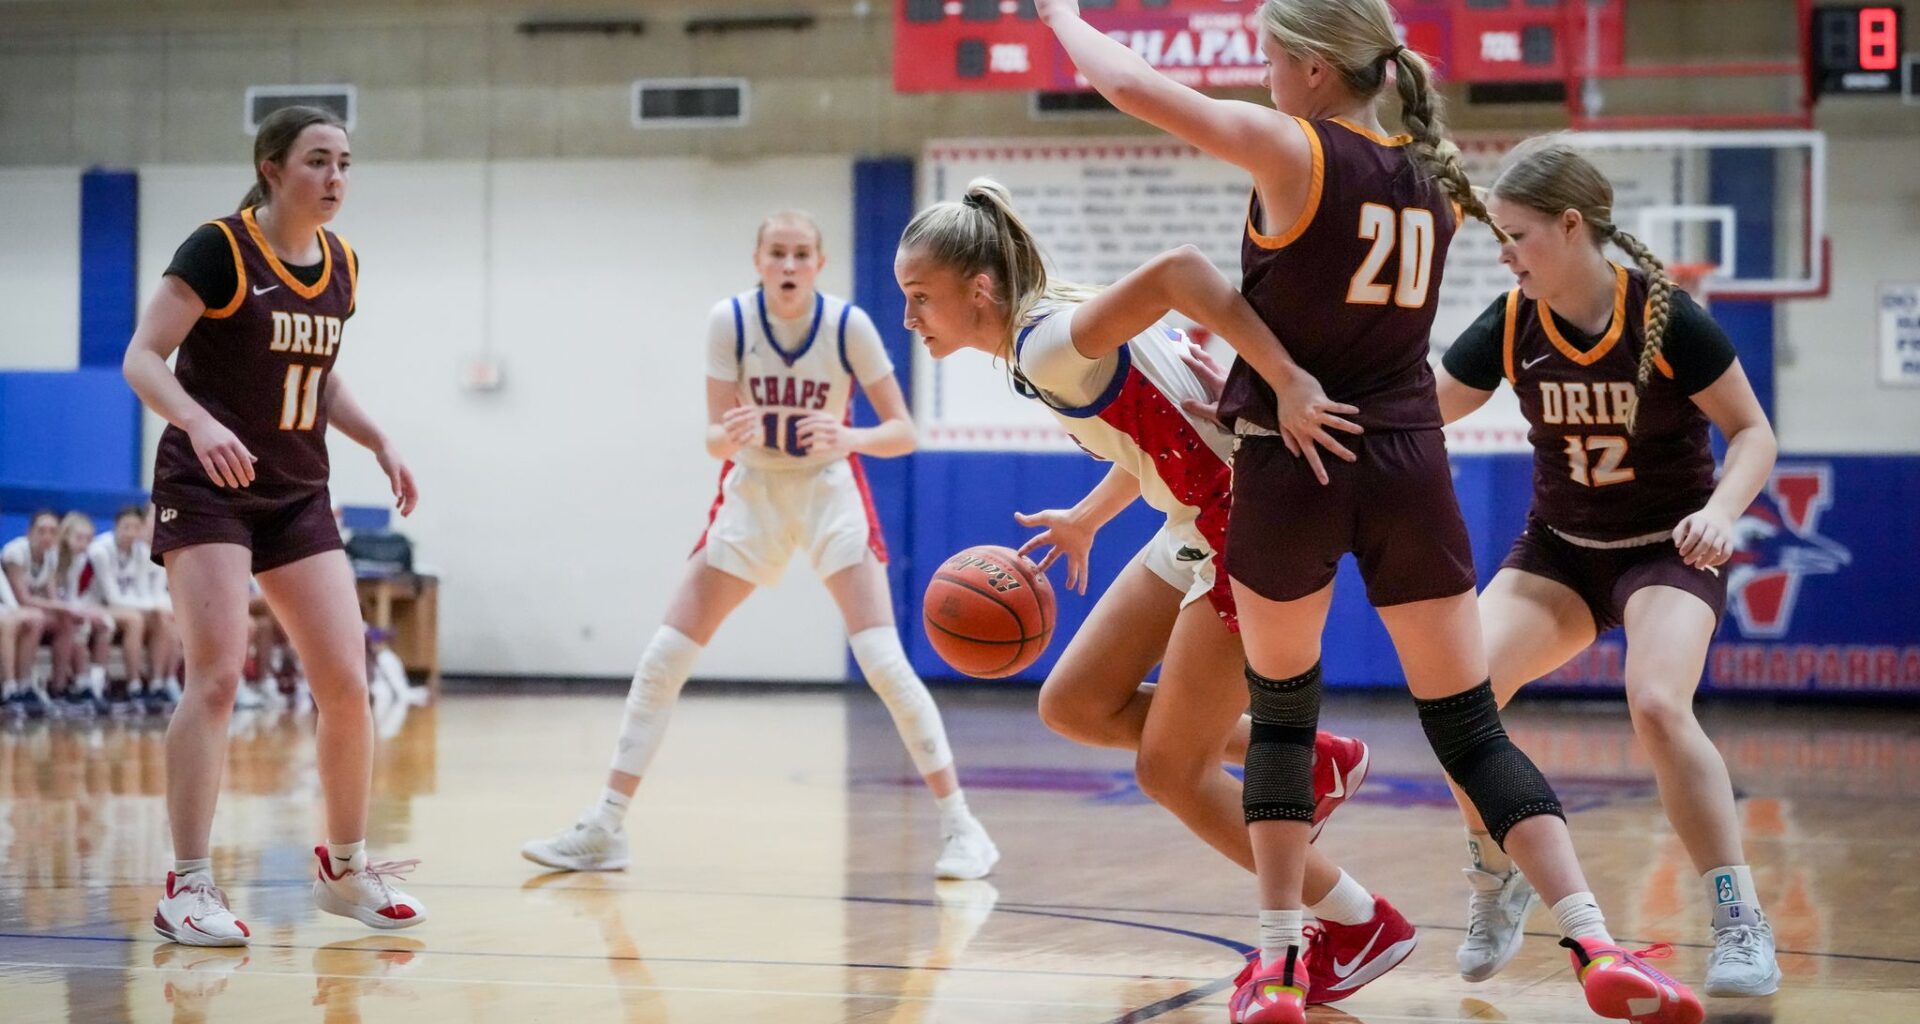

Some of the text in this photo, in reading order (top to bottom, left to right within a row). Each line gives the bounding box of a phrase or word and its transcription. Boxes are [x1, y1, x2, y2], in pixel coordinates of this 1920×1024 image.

[1859, 7, 1897, 70] 8
[1345, 201, 1435, 308] 20
[270, 310, 341, 356] DRIP
[279, 363, 323, 431] 11
[749, 376, 831, 410] CHAPS
[1540, 381, 1637, 425] DRIP
[1563, 435, 1636, 488] 12
